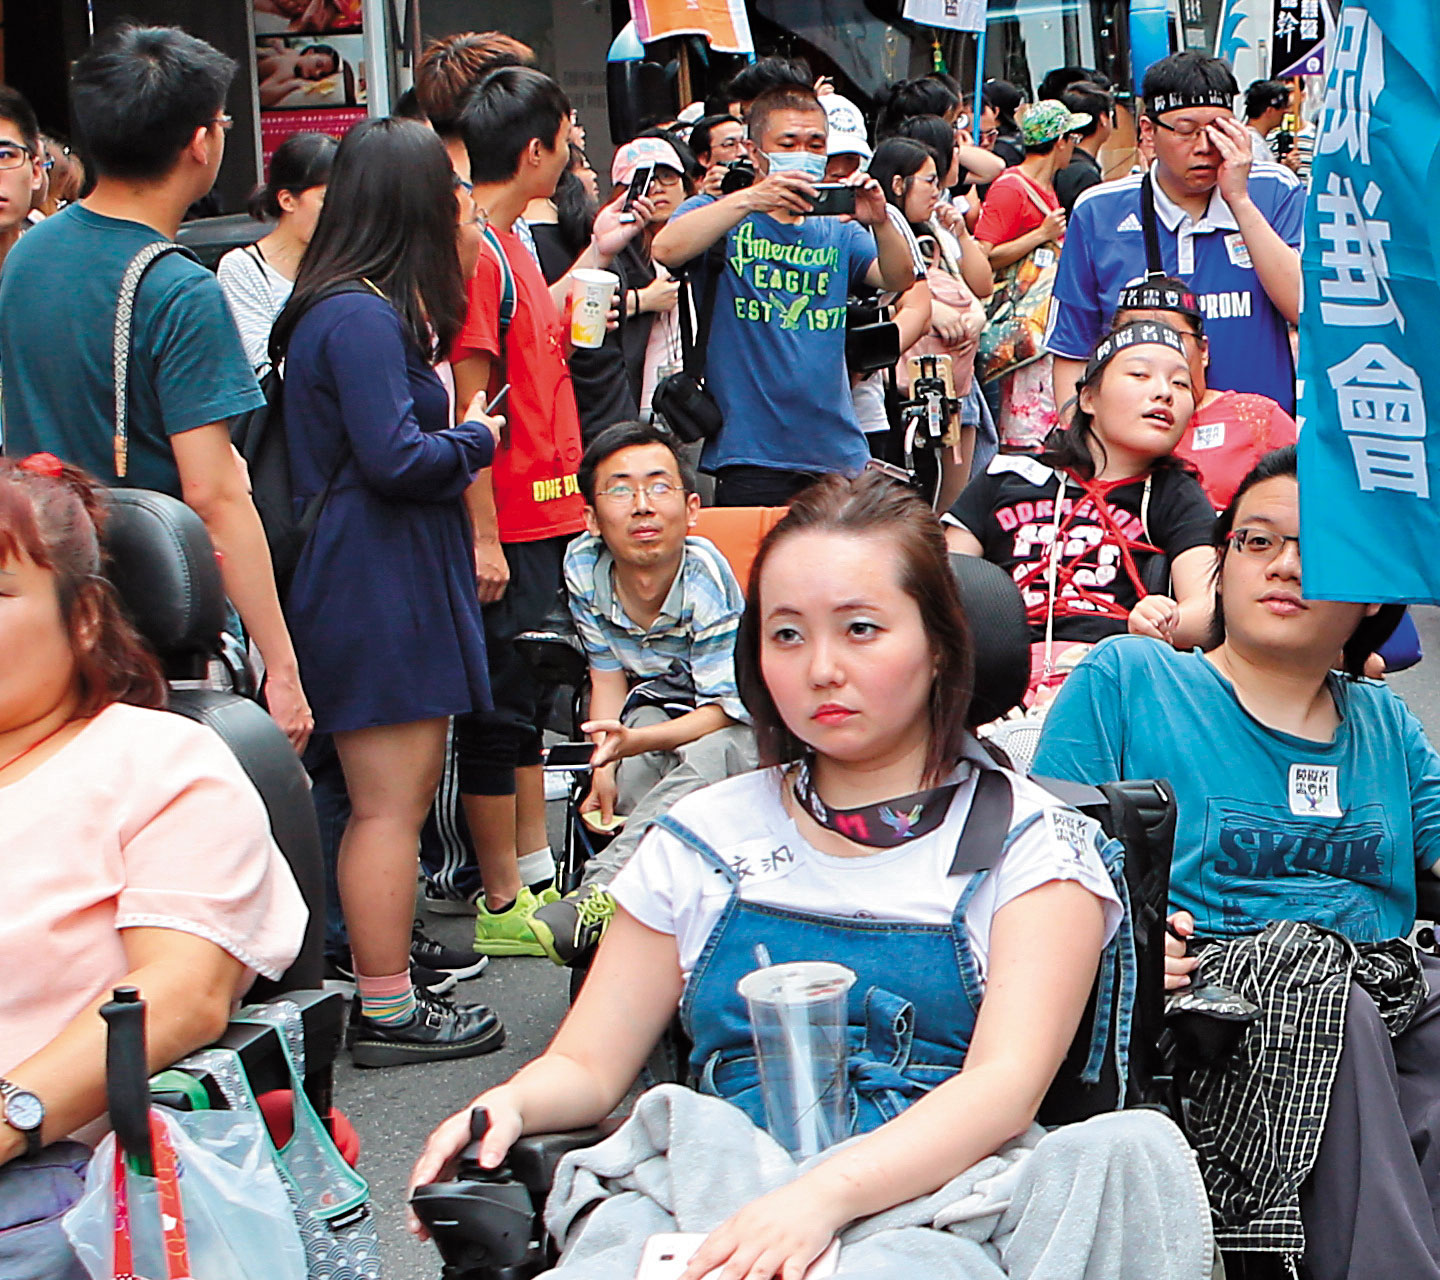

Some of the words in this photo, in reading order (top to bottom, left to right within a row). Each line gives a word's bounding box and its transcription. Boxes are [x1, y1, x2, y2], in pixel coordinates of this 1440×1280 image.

[731, 223, 840, 277] American
[753, 264, 829, 296] EAGLE
[734, 295, 773, 324] EST
[532, 477, 563, 503] ONE
